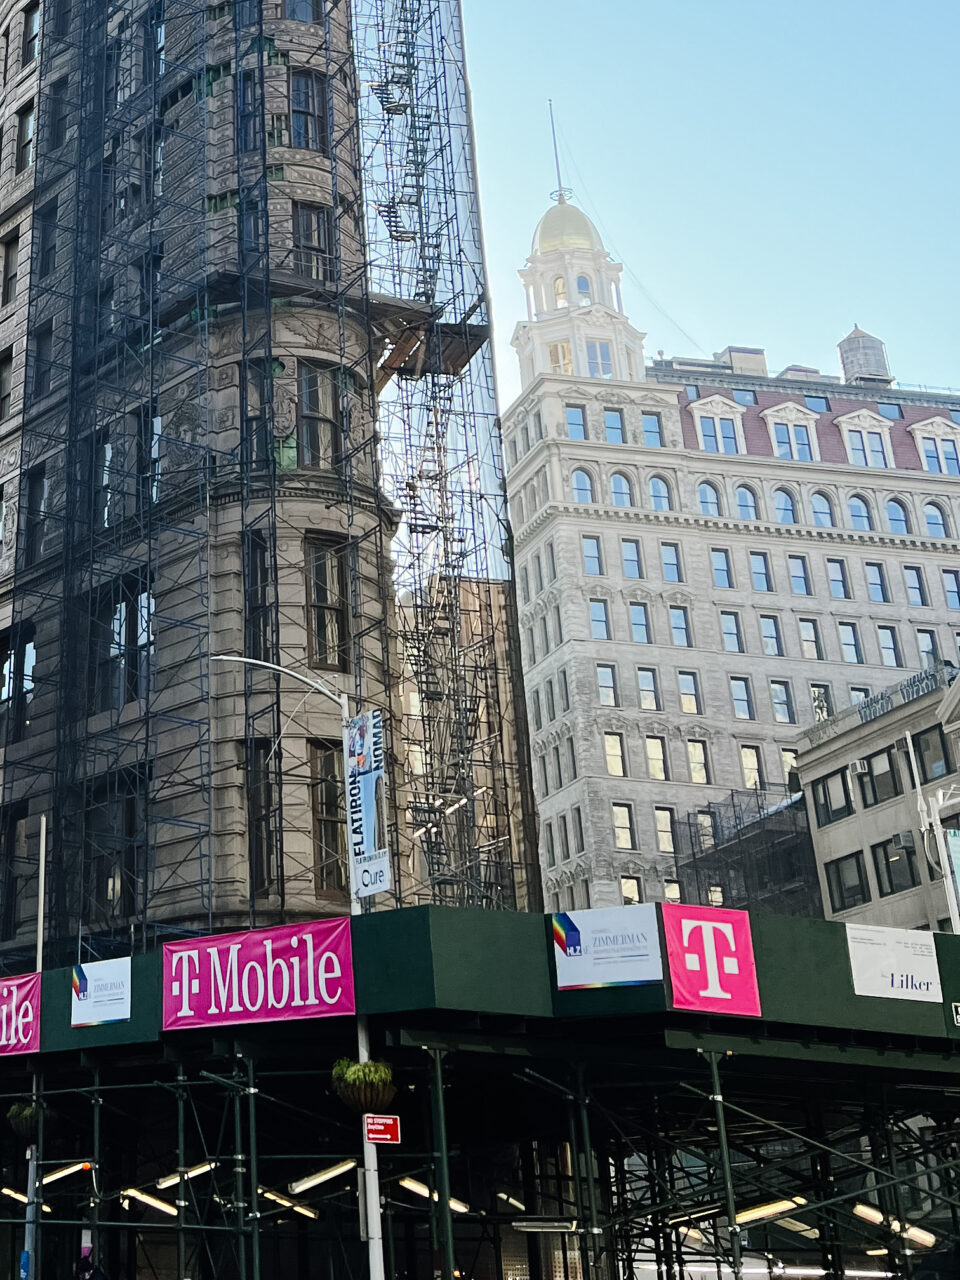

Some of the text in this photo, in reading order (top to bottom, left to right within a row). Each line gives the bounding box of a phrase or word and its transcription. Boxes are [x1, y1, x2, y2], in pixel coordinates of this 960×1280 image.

[371, 707, 384, 771] NOMAD
[349, 772, 366, 857] FLATIRON
[362, 869, 385, 888] Cure
[681, 919, 739, 1000] T
[890, 972, 933, 992] Lilker
